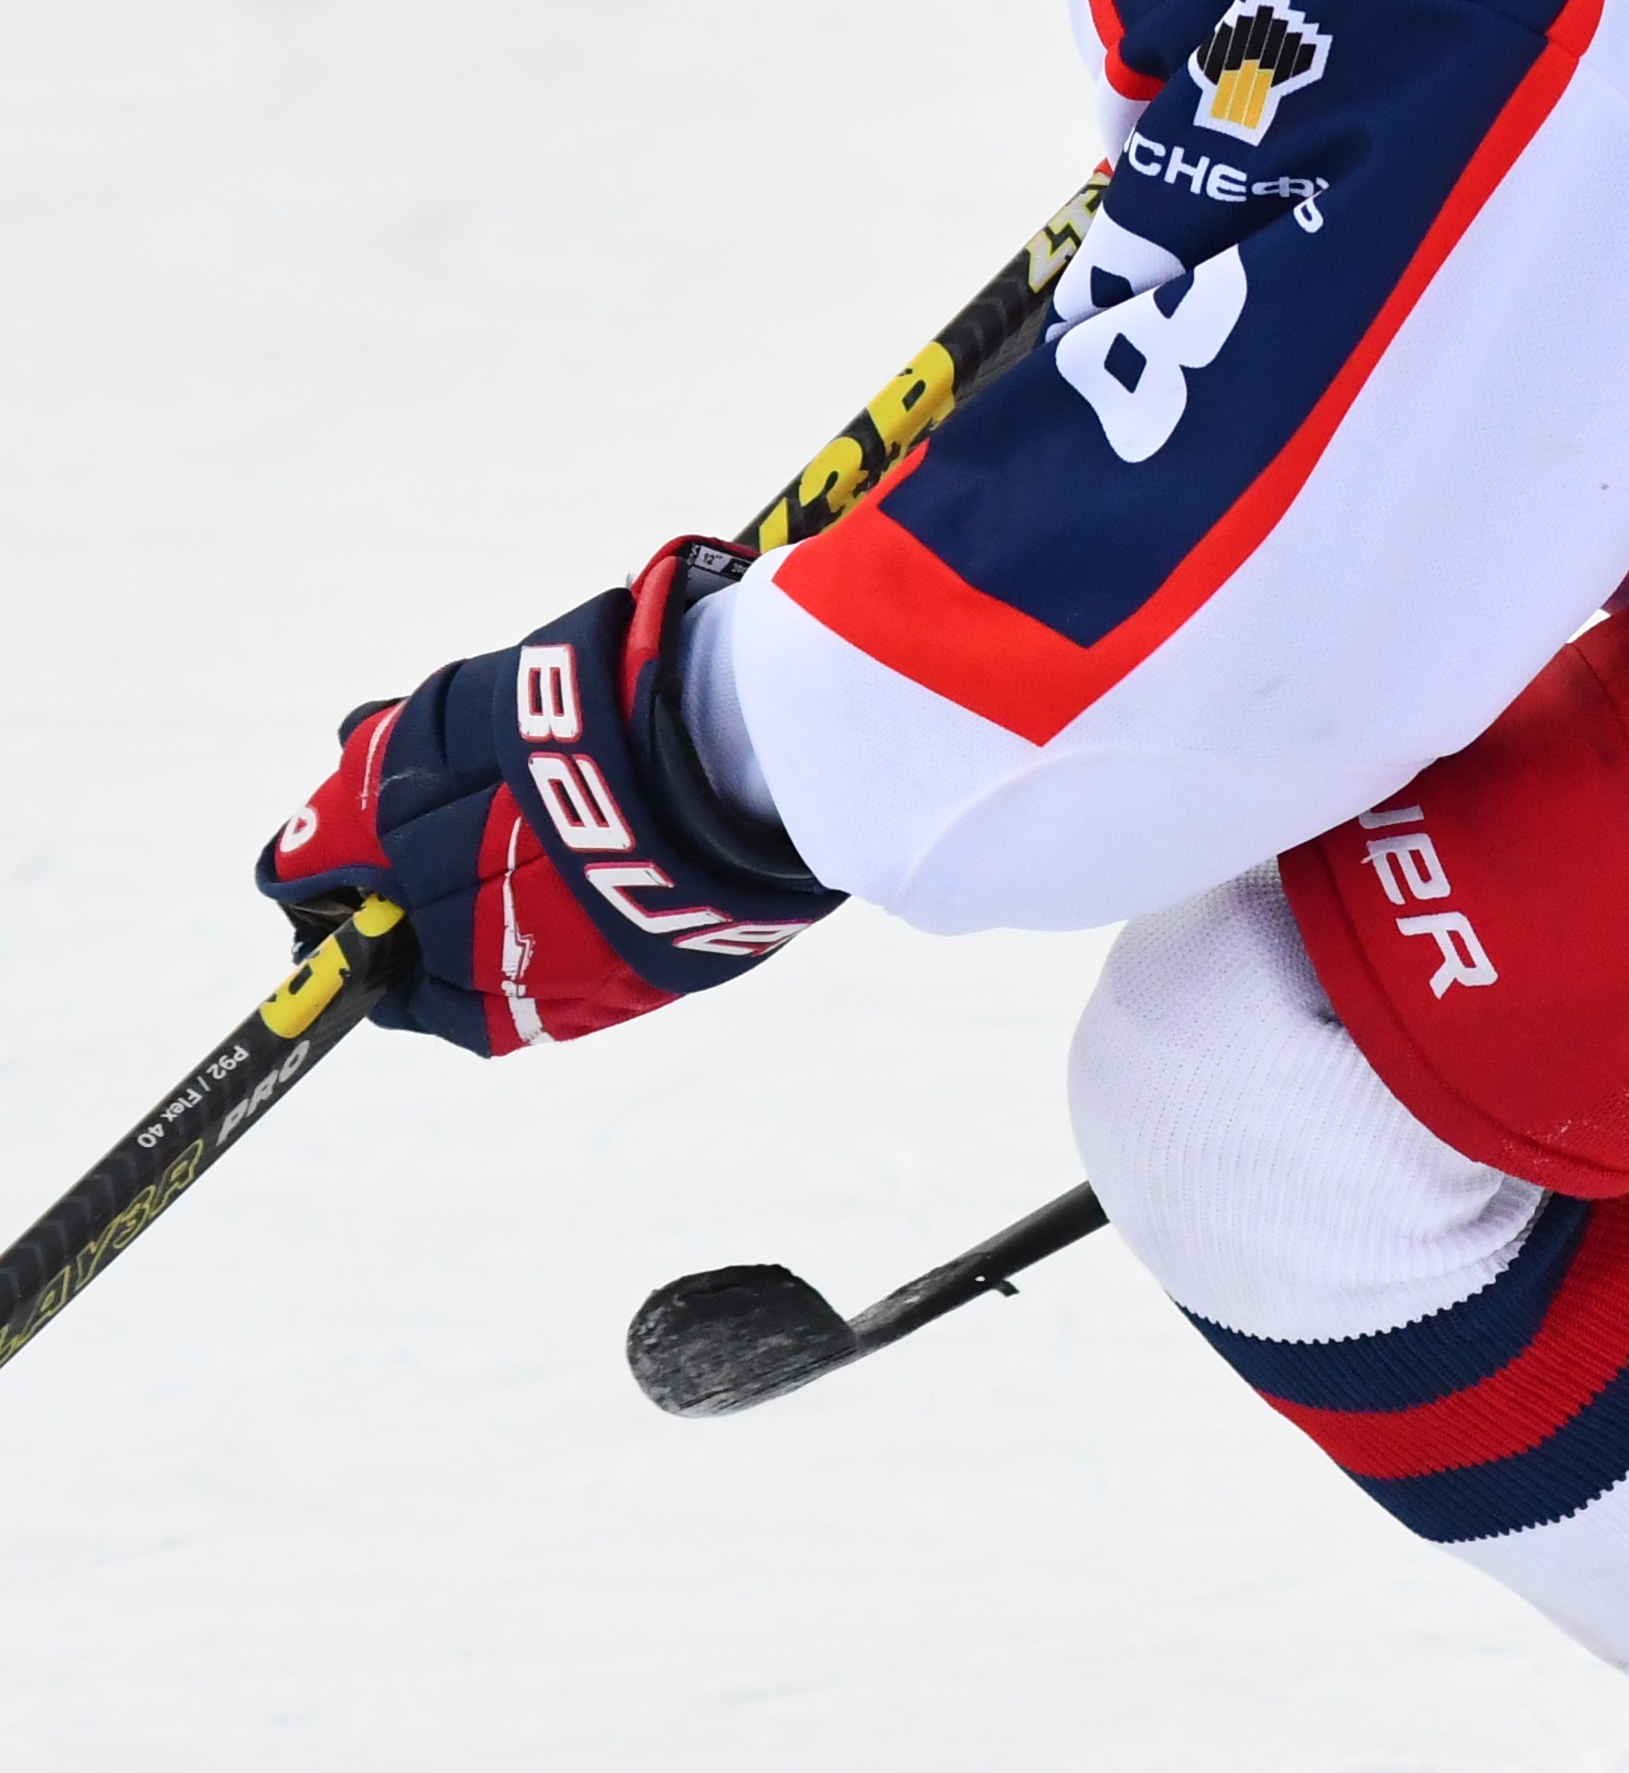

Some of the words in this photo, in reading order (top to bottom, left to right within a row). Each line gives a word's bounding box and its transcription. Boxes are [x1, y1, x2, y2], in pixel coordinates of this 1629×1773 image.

[516, 643, 813, 958] BAUE
[206, 1043, 250, 1080] P92
[160, 1085, 203, 1123] Flex
[136, 1122, 167, 1149] 40
